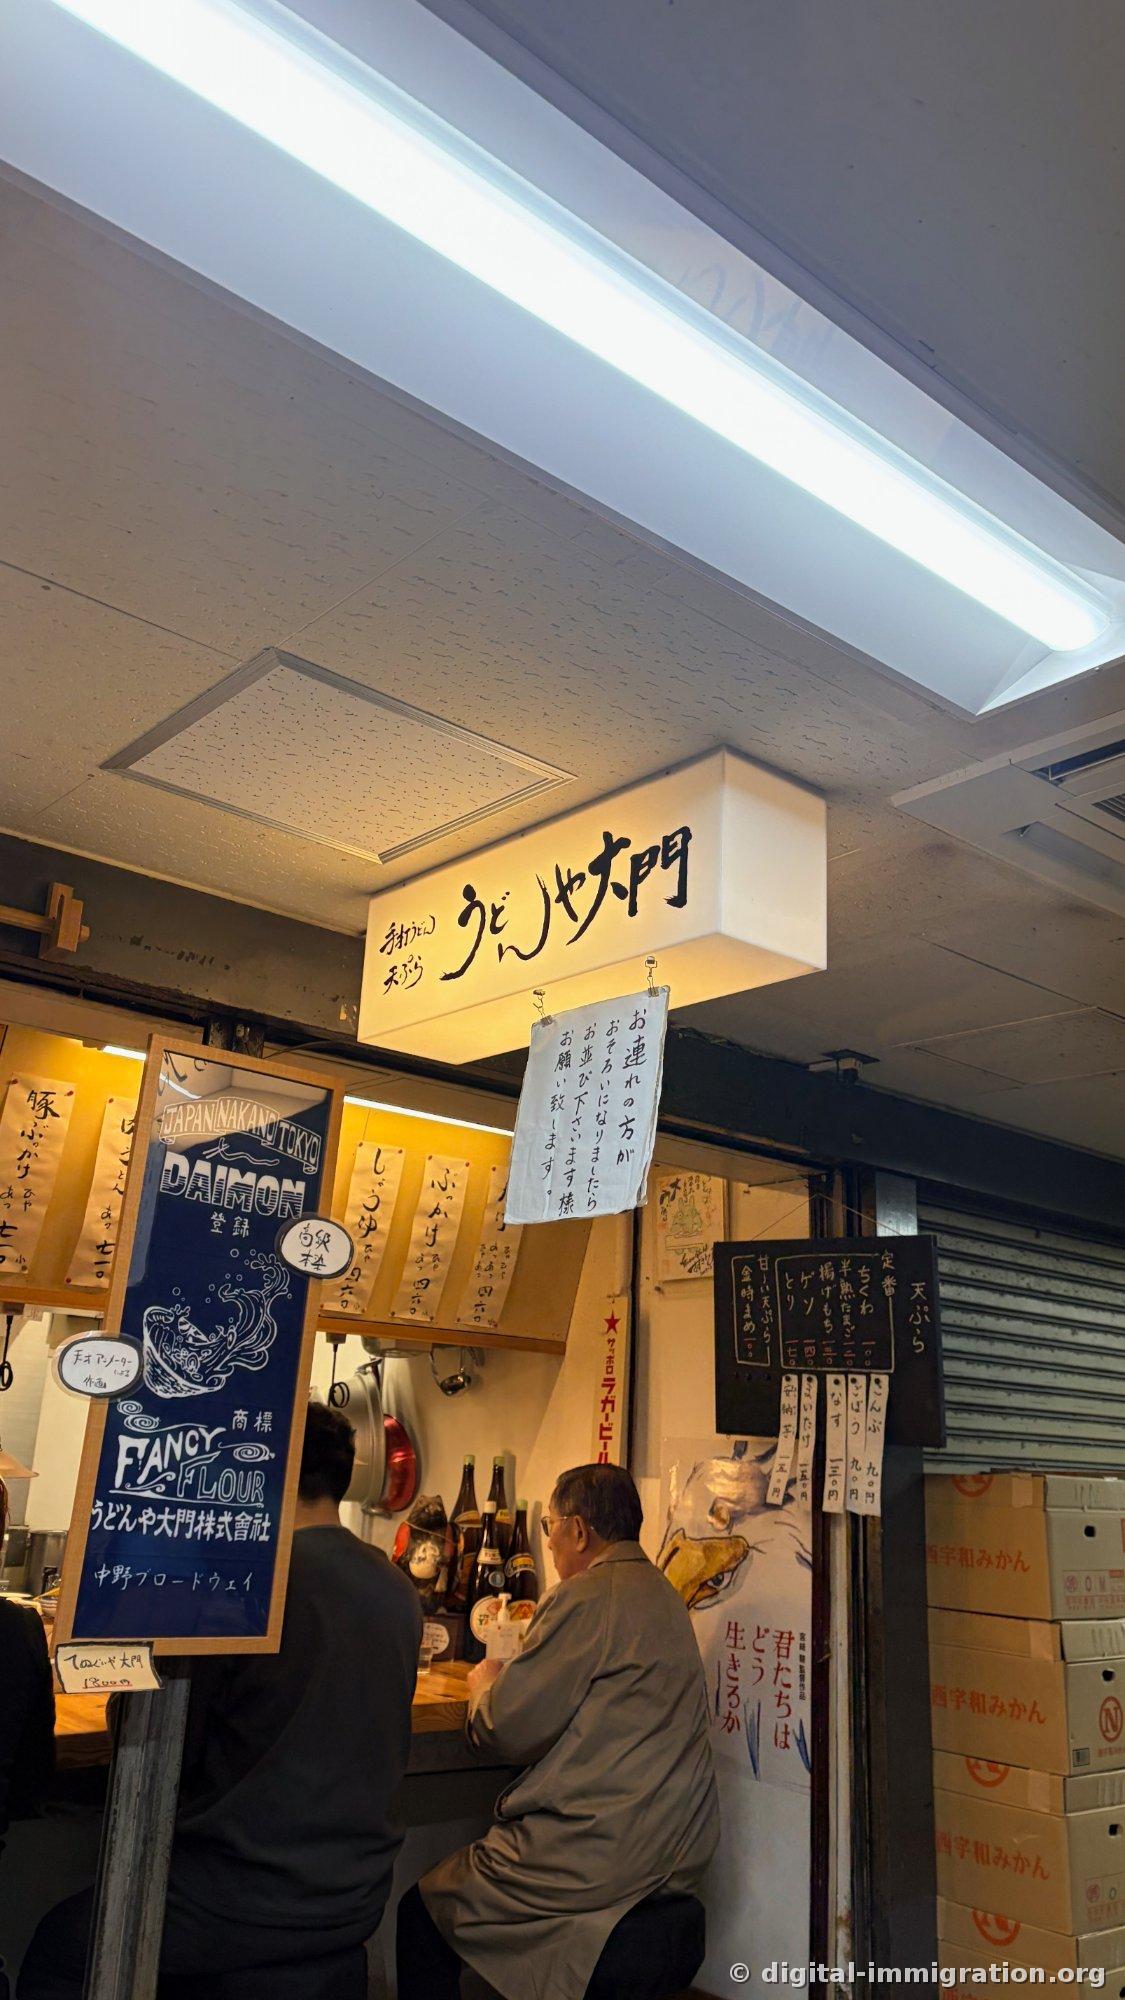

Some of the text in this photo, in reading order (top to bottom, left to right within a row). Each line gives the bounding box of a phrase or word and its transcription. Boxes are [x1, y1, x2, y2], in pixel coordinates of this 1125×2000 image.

[439, 825, 693, 981] うどんや大門
[382, 954, 425, 995] 天ぷら
[585, 1019, 620, 1213] おそろいになりましたら
[616, 1008, 647, 1166] お連れの方が
[17, 1090, 60, 1179] 豚ぶっかけ
[164, 1099, 320, 1164] JAPAN NAKANO TOKYO
[160, 1151, 305, 1219] DAIMON
[358, 1148, 386, 1239] しょうゆ
[426, 1168, 458, 1247] ぶっかけ
[210, 1211, 250, 1238] 登録
[785, 1272, 794, 1311] とり
[801, 1271, 815, 1315] ゲソ
[839, 1258, 856, 1338] 半熟たまご
[858, 1265, 874, 1315] ちくわ
[881, 1250, 898, 1297] 定番
[908, 1282, 931, 1354] 天ぷら
[232, 1408, 273, 1433] 商標
[830, 1391, 842, 1428] なす
[114, 1427, 226, 1489] FANCY
[177, 1451, 266, 1504] FLOUR
[91, 1499, 272, 1542] うどんや大門株式會社
[94, 1563, 257, 1592] 中野ブロードウェイ
[720, 1621, 746, 1734] 生きるか
[752, 1625, 770, 1686] どう
[772, 1629, 796, 1750] 君たちは
